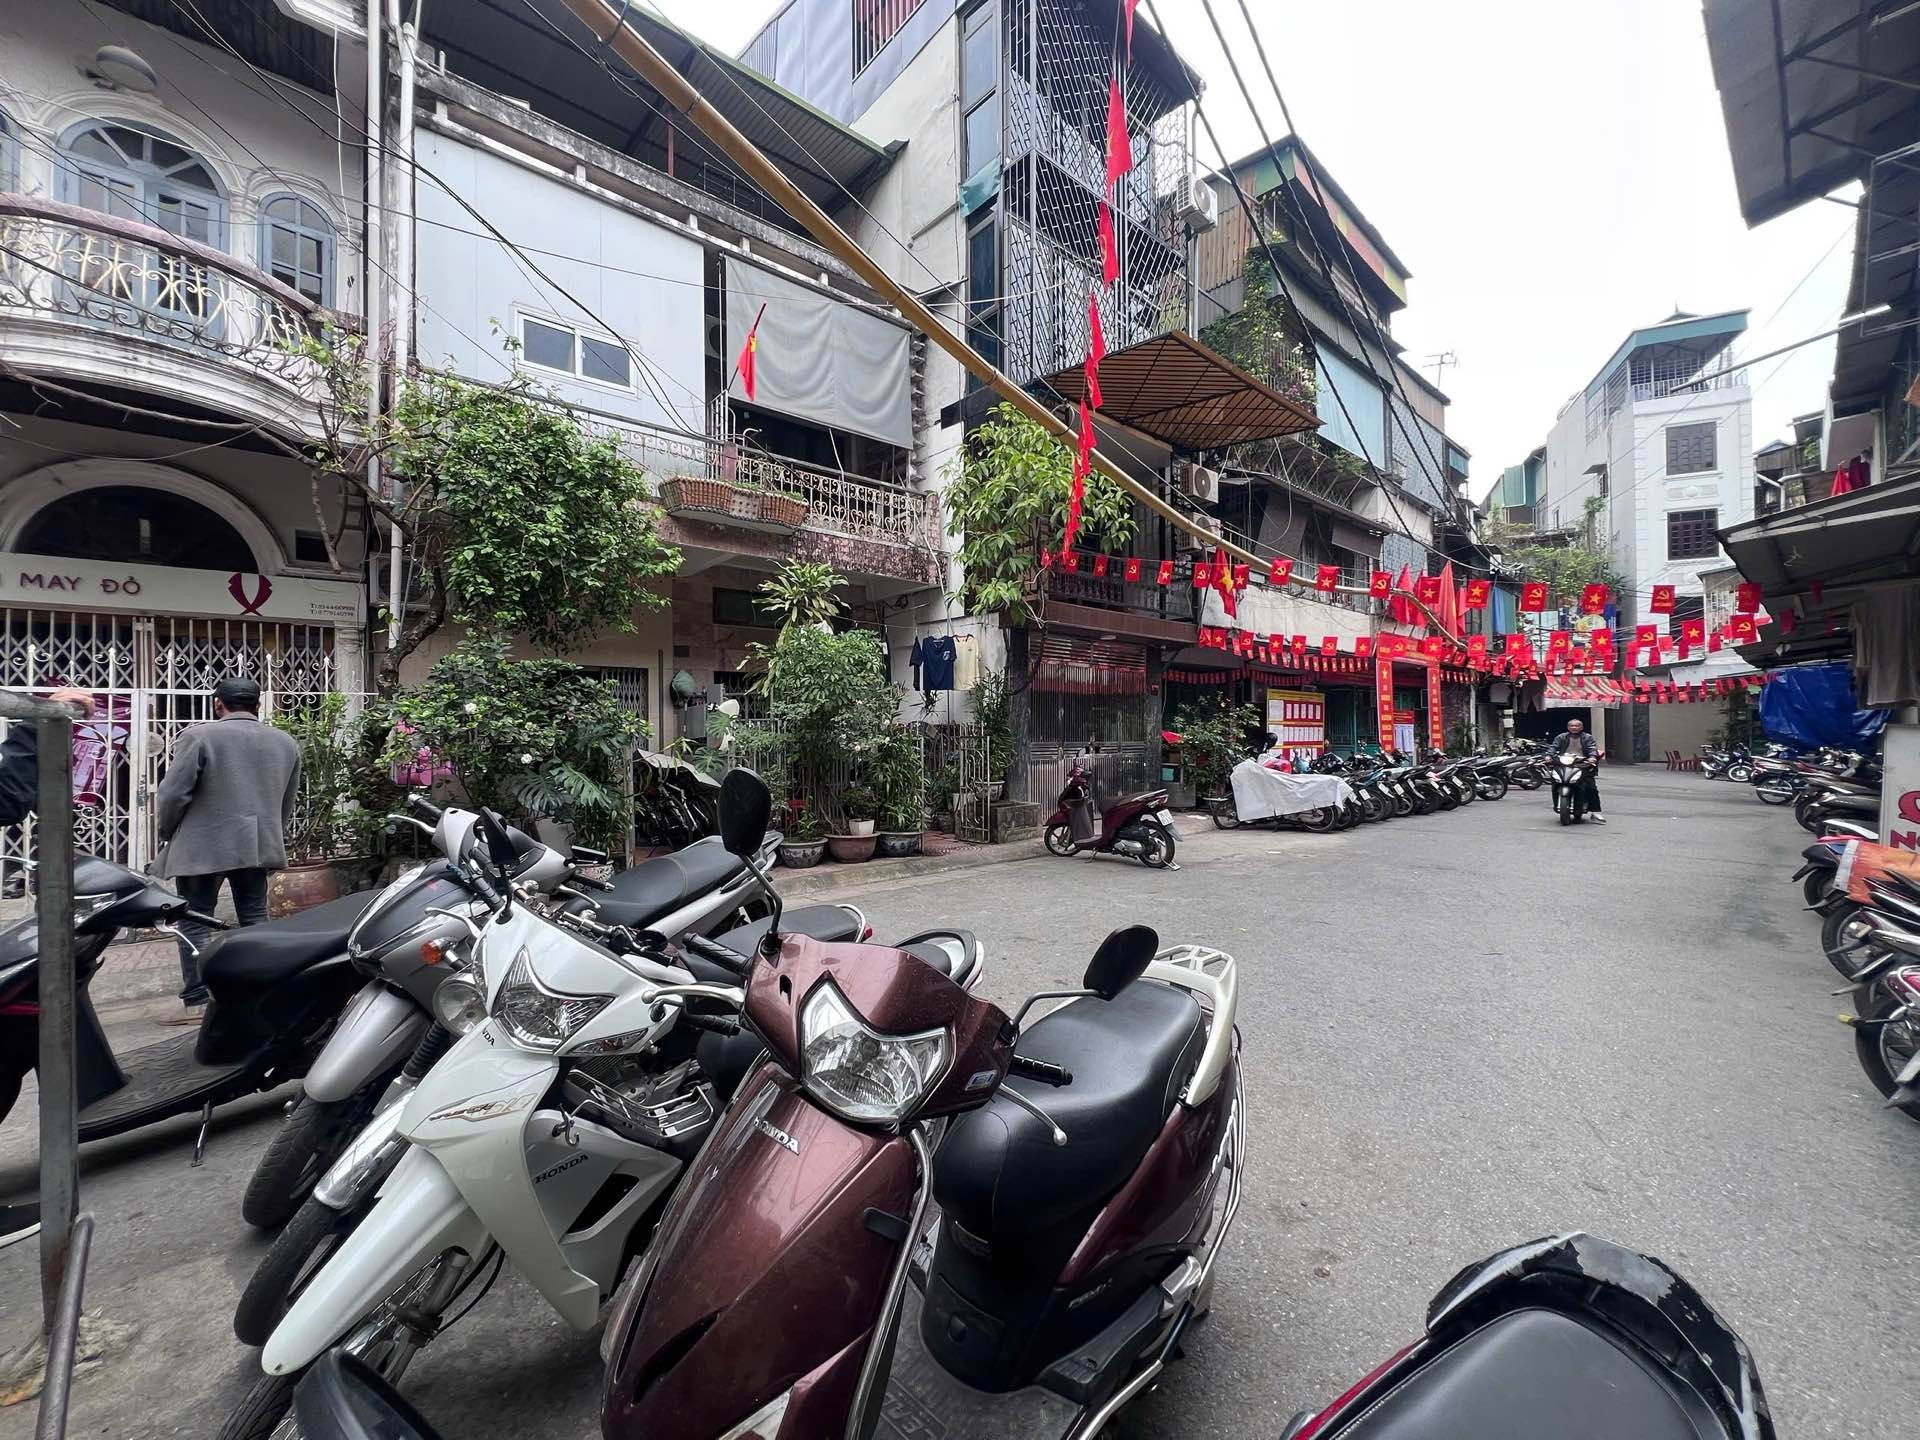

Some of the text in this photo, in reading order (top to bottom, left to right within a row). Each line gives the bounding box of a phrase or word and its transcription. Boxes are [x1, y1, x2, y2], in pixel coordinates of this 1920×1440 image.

[20, 572, 81, 591] MAY
[100, 576, 140, 595] ĐỎ
[754, 1116, 800, 1155] HONDA
[535, 1154, 589, 1184] HONDA
